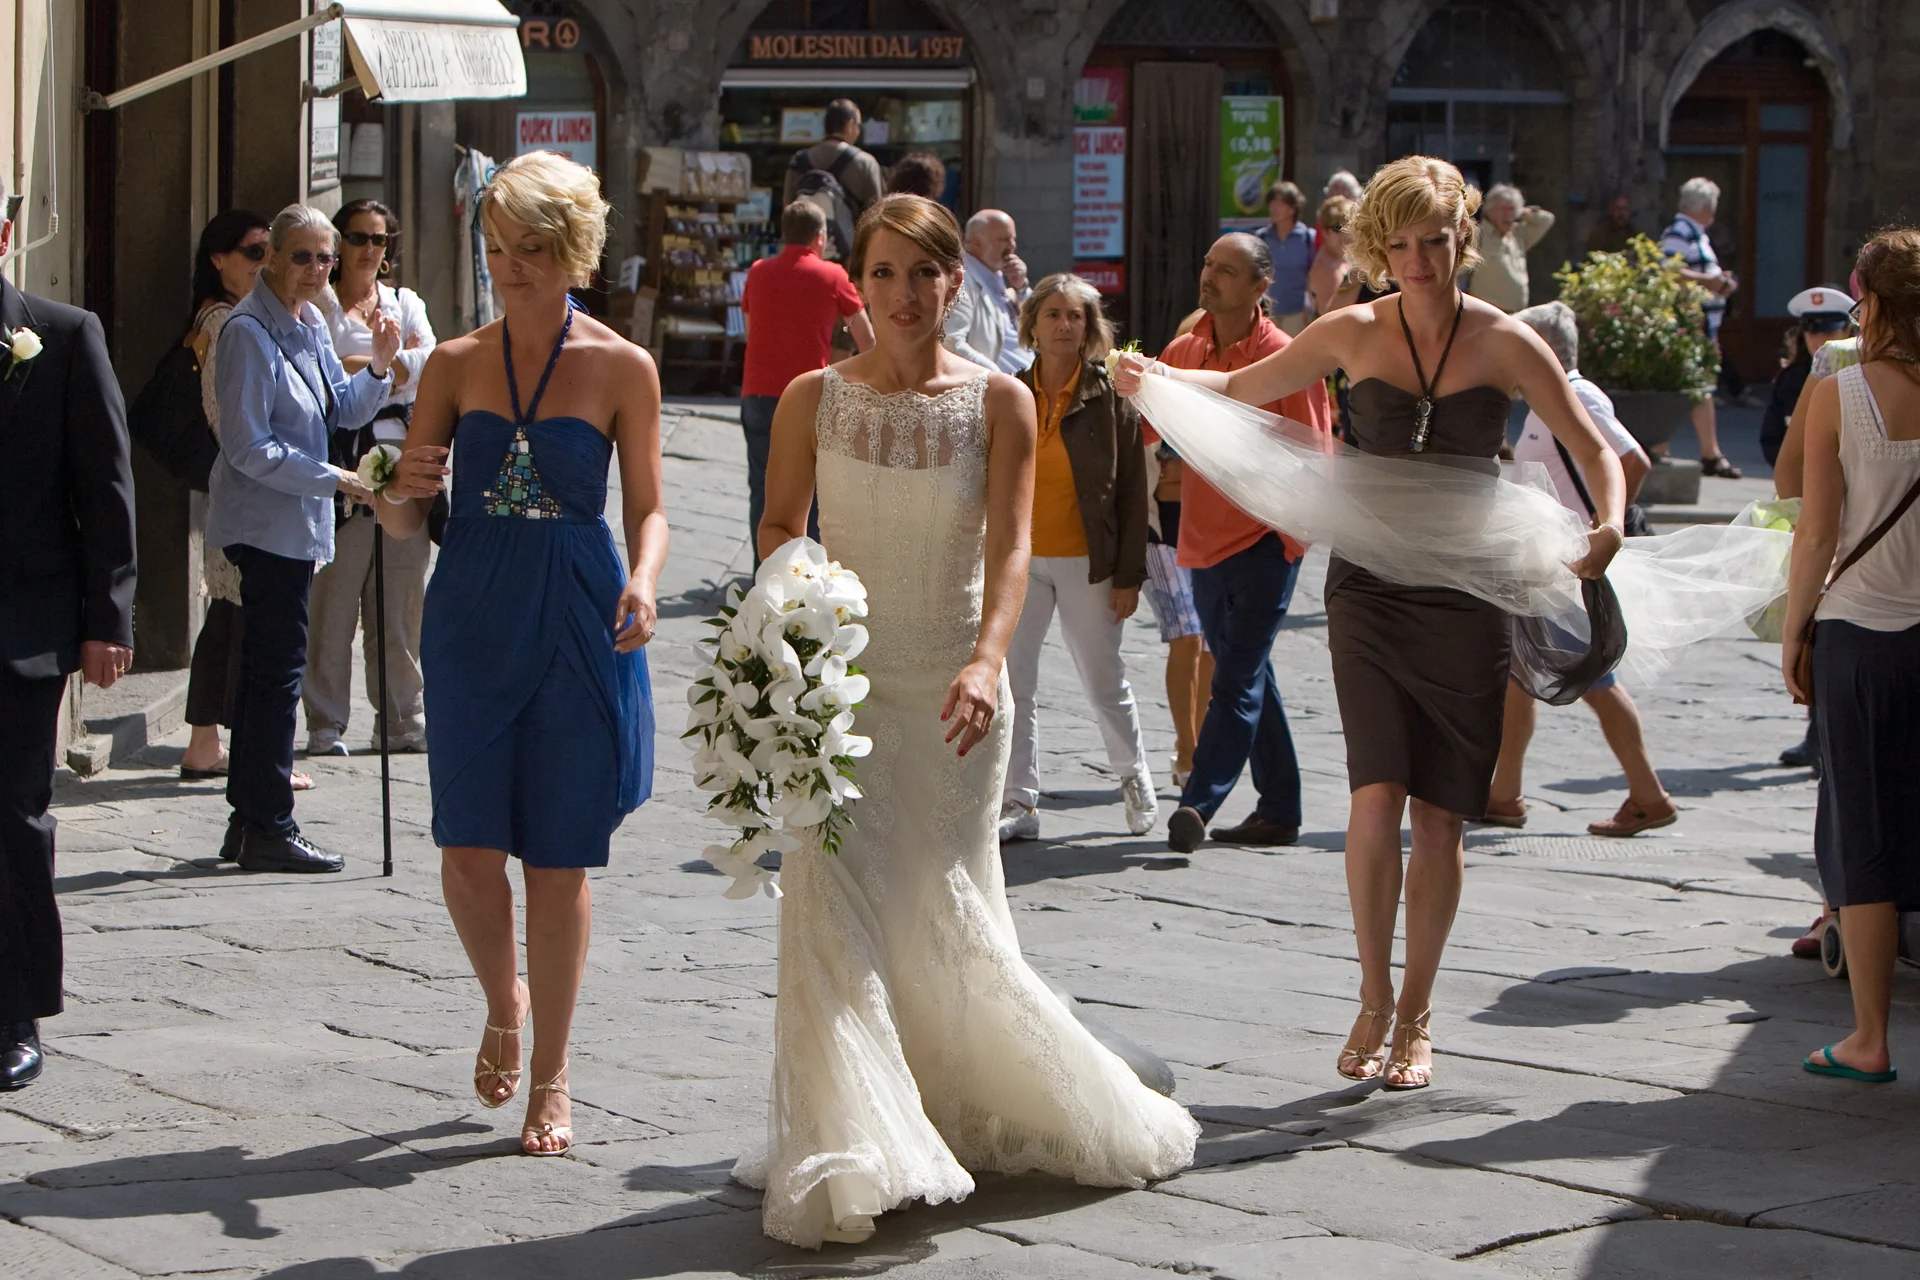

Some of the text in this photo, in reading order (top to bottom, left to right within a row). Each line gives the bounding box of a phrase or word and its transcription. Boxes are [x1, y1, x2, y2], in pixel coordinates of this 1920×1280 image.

[752, 35, 963, 59] MOLESINI DAL 1937
[520, 117, 592, 146] QUICK LUNCH
